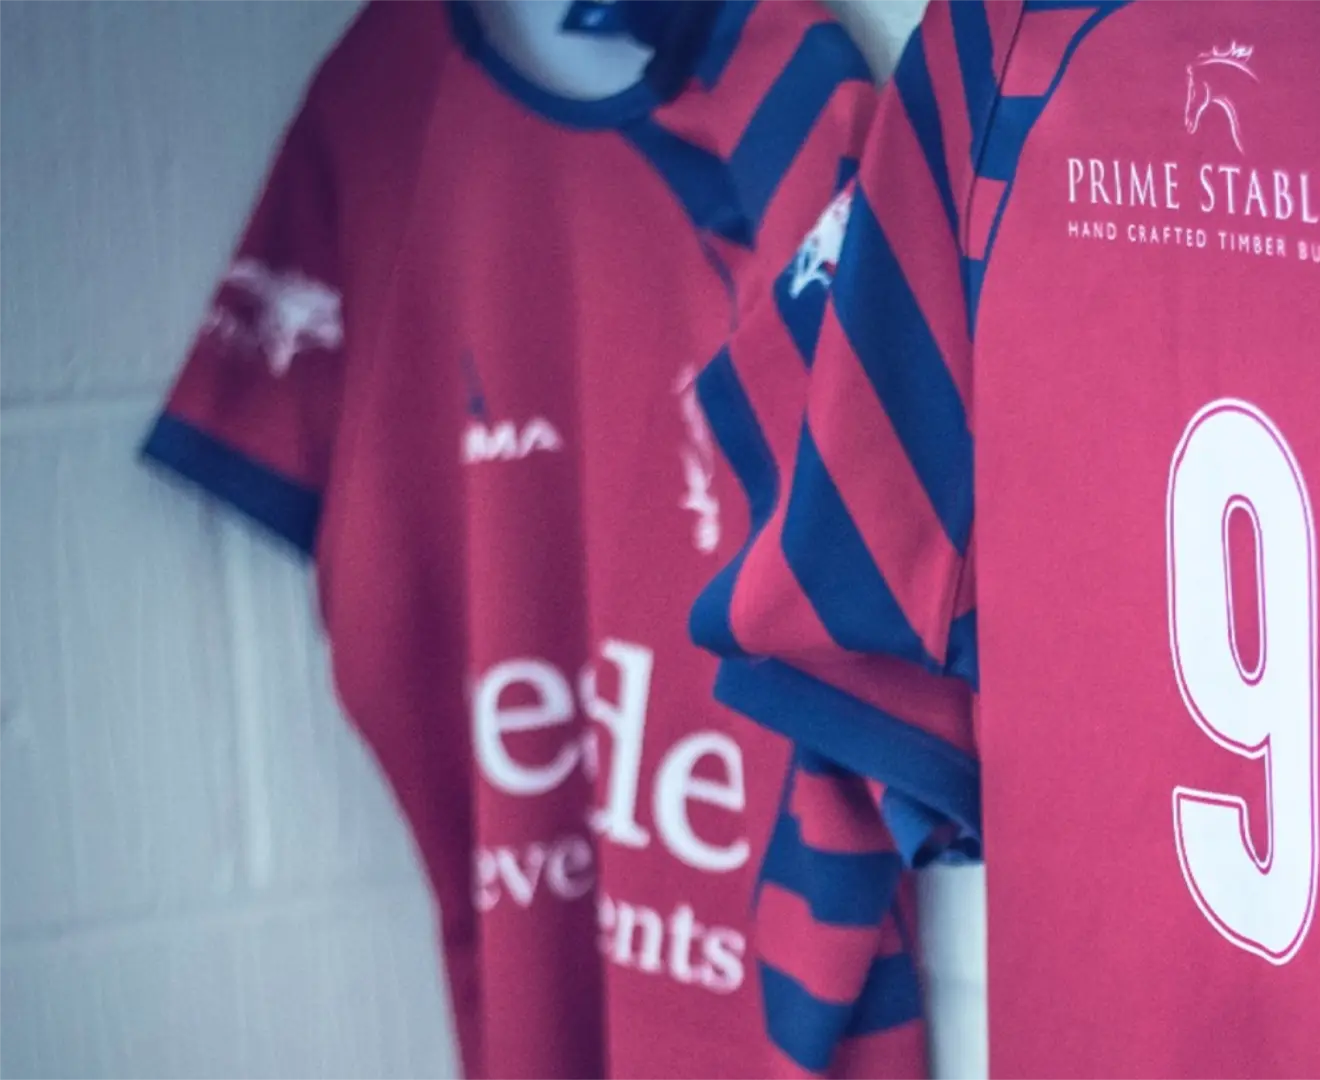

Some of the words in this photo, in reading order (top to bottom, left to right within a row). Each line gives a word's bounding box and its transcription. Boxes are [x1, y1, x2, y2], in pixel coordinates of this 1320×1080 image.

[1067, 157, 1180, 210] PRIME
[1067, 220, 1118, 241] HAND
[1127, 223, 1207, 248] CRAFTED
[1217, 231, 1286, 257] TIMBER
[1165, 397, 1319, 966] 9
